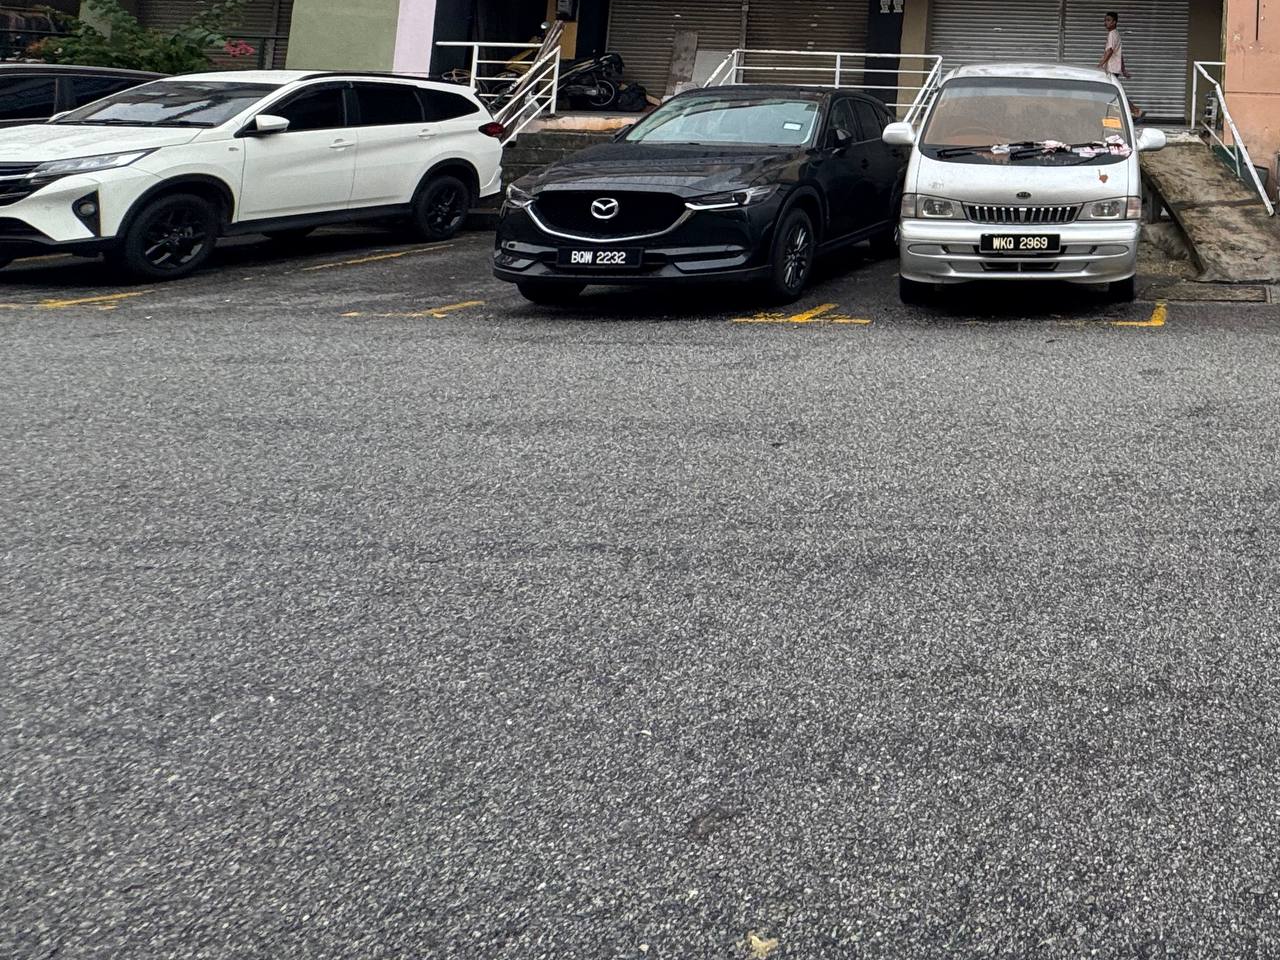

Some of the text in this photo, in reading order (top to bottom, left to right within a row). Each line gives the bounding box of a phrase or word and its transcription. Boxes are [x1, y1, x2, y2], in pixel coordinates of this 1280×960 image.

[993, 237, 1048, 249] WKQ 2969
[571, 251, 626, 264] BQW 2232
